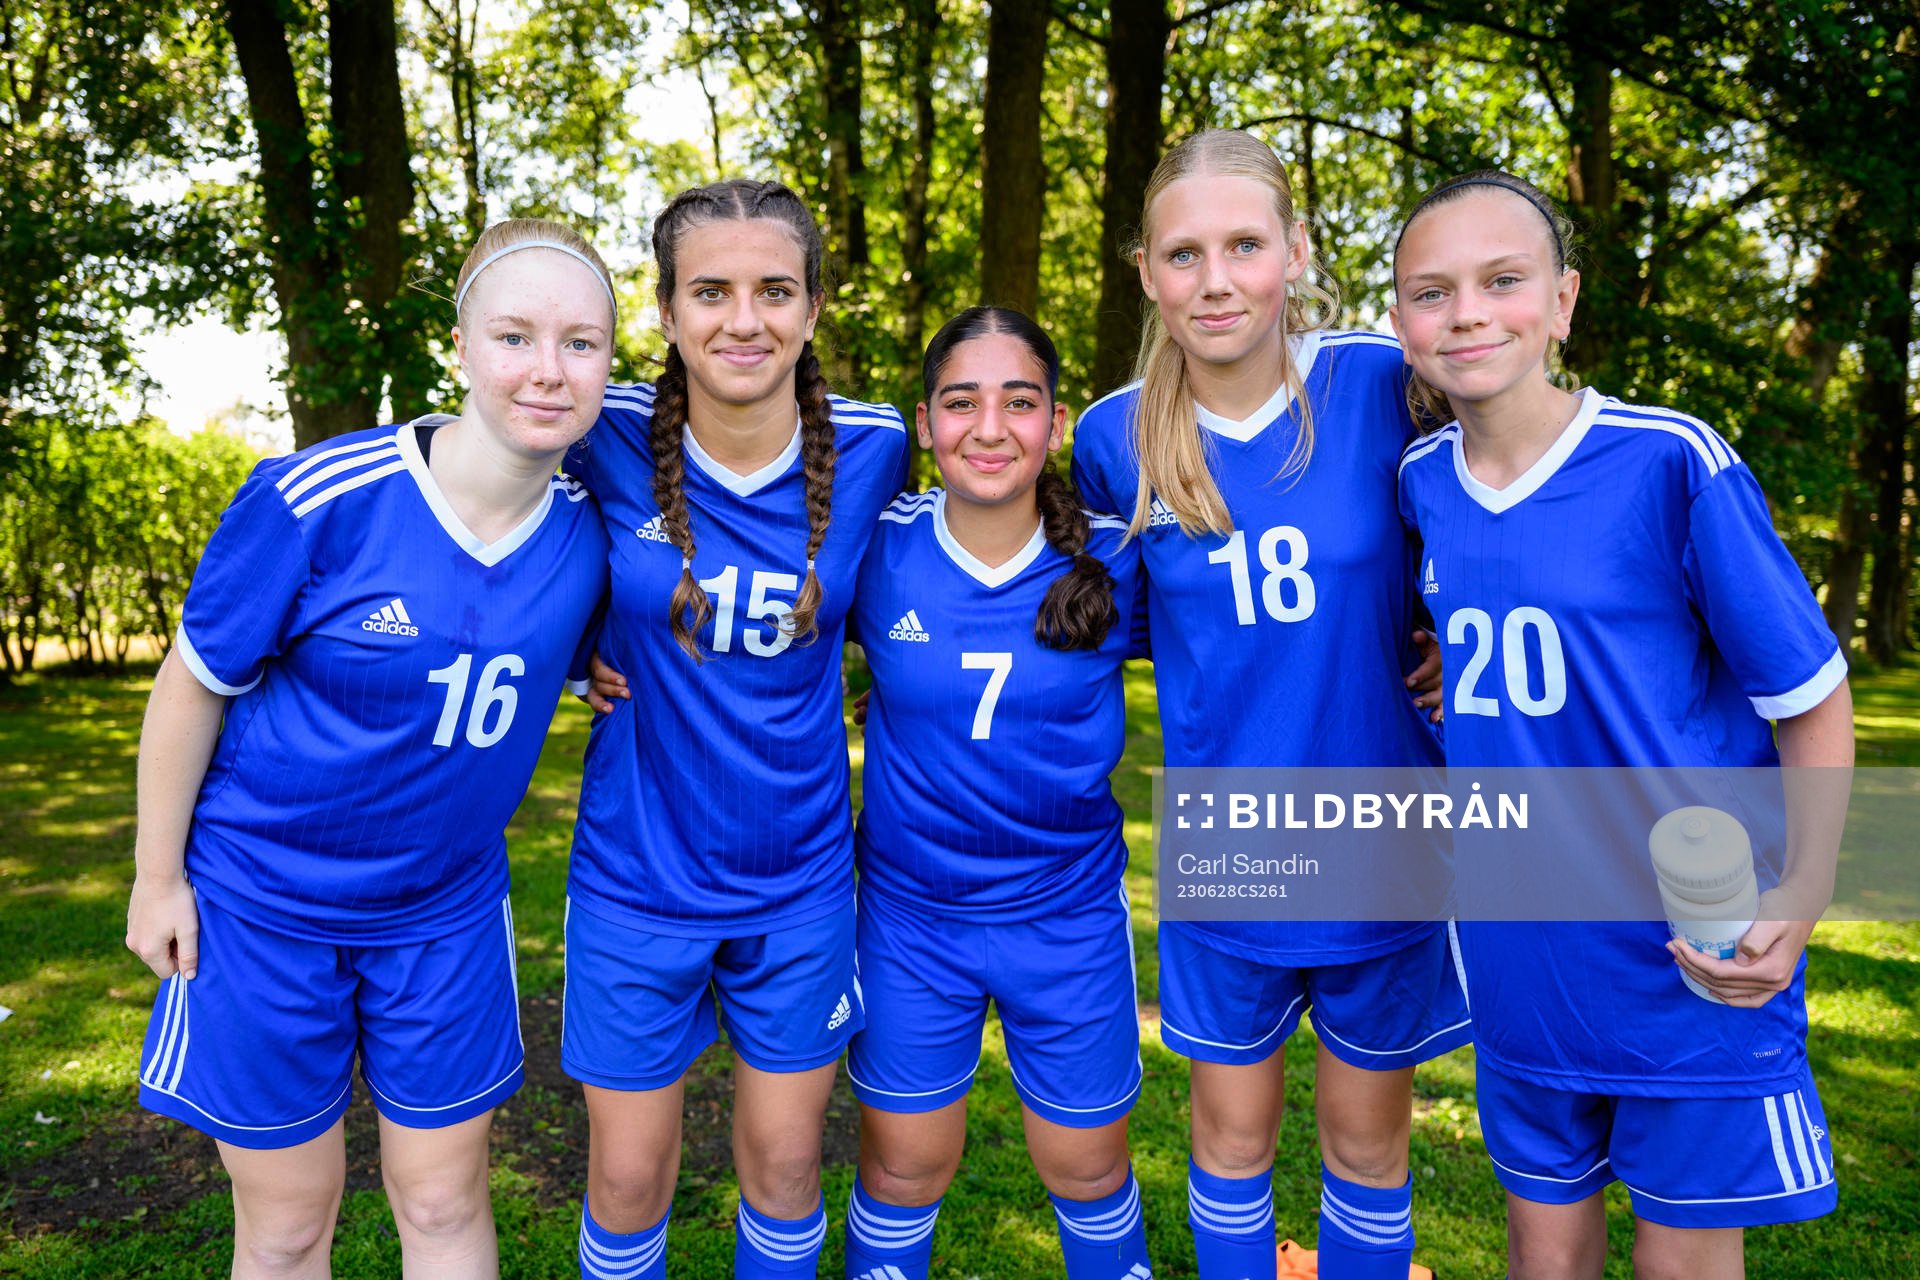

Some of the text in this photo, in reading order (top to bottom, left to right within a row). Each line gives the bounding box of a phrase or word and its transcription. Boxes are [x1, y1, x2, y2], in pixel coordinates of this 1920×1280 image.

[636, 528, 672, 544] adid
[1147, 510, 1180, 526] dida
[699, 565, 798, 657] 15
[1208, 525, 1316, 626] 18
[362, 619, 419, 636] adidas
[888, 629, 930, 643] adidas
[1447, 606, 1567, 717] 20
[427, 653, 526, 749] 16
[961, 652, 1013, 740] 7
